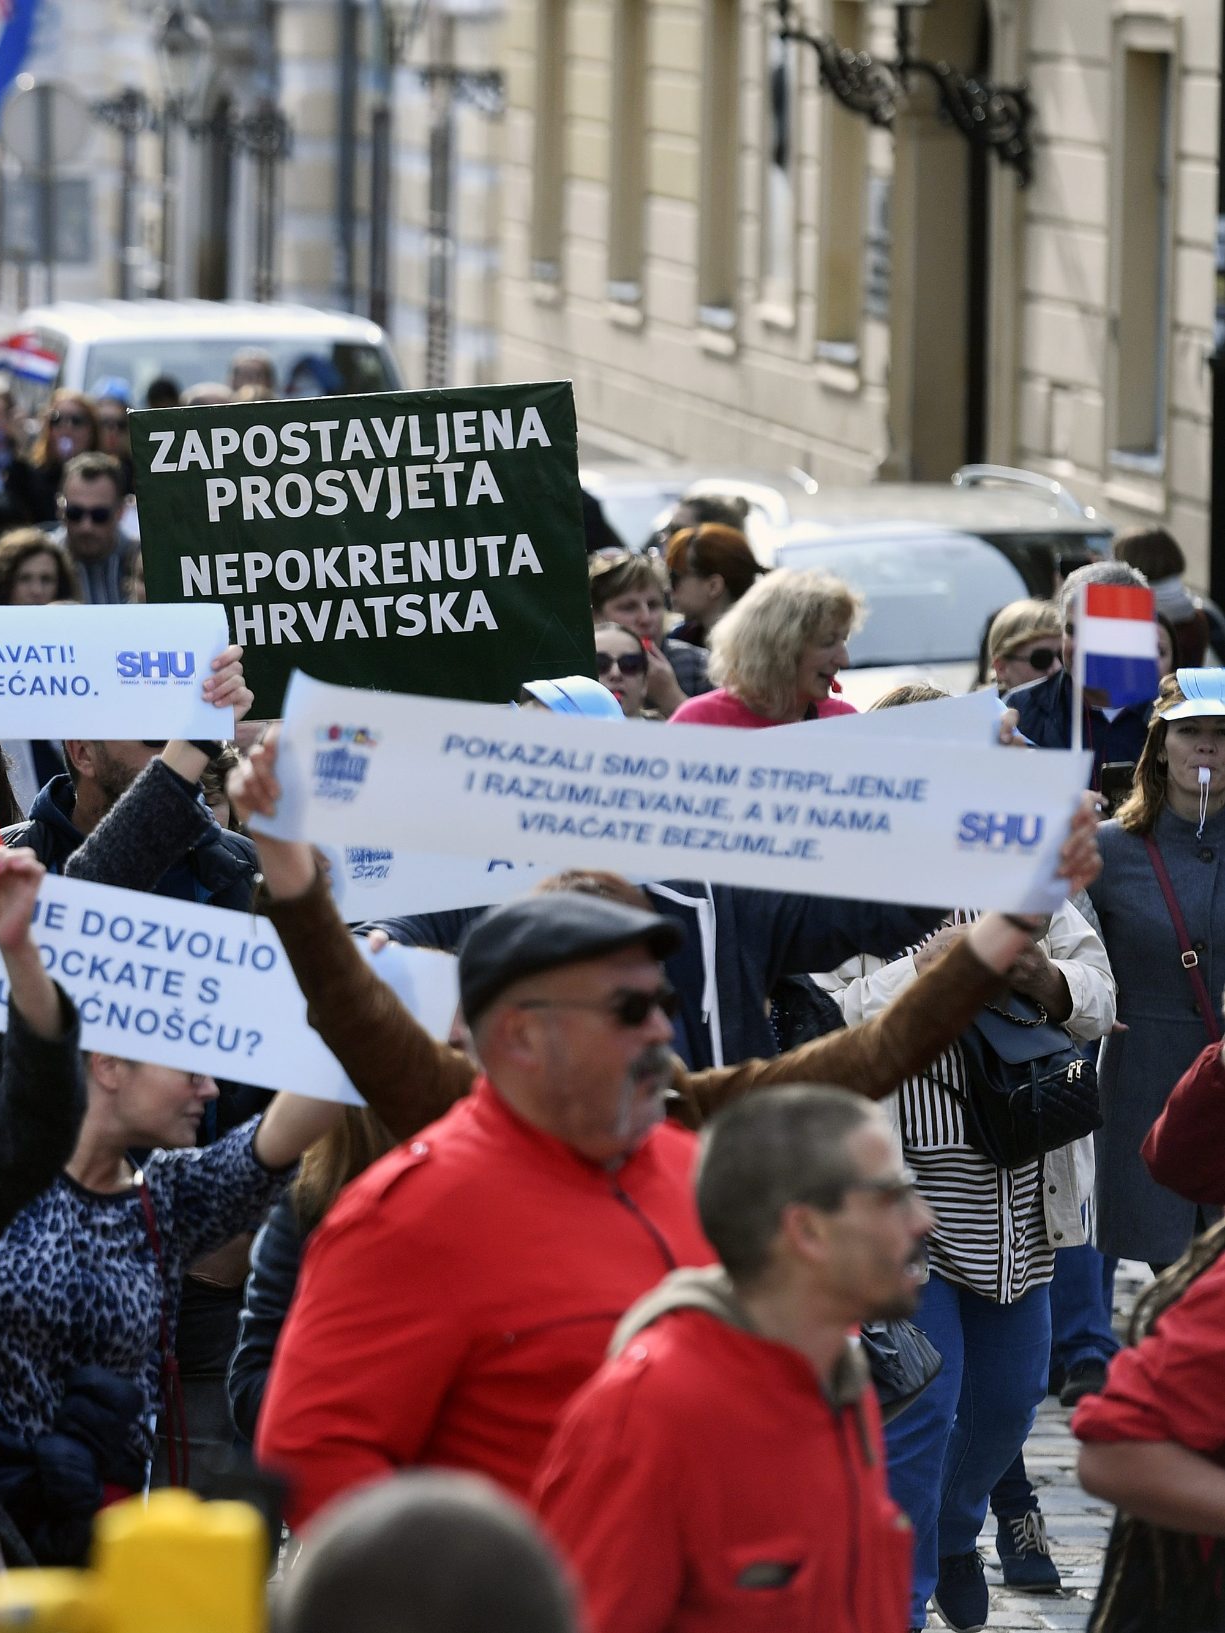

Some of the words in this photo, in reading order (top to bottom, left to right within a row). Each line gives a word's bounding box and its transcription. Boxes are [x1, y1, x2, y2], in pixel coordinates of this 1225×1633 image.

[148, 406, 552, 473] ZAPOSTAVLJENA
[205, 459, 504, 523] PROSVJETA
[180, 533, 544, 597] NEPOKRENUTA
[233, 589, 499, 647] HRVATSKA
[117, 651, 195, 678] SHU
[442, 733, 595, 773] POKAZALI
[602, 753, 670, 780] SMO
[679, 760, 739, 787] VAM
[747, 767, 930, 801] STRPLJENJE
[464, 770, 476, 793] I
[482, 772, 735, 823] RAZUMIJEVANJE,
[744, 802, 764, 823] A
[770, 803, 798, 826] VI
[804, 807, 893, 834] NAMA
[958, 811, 1044, 847] SHU
[518, 811, 657, 845] VRAĆATE
[662, 823, 824, 861] BEZUMLJE.
[80, 909, 277, 973] DOZVOLIO
[39, 944, 186, 998] OCKATE
[198, 976, 221, 1005] S
